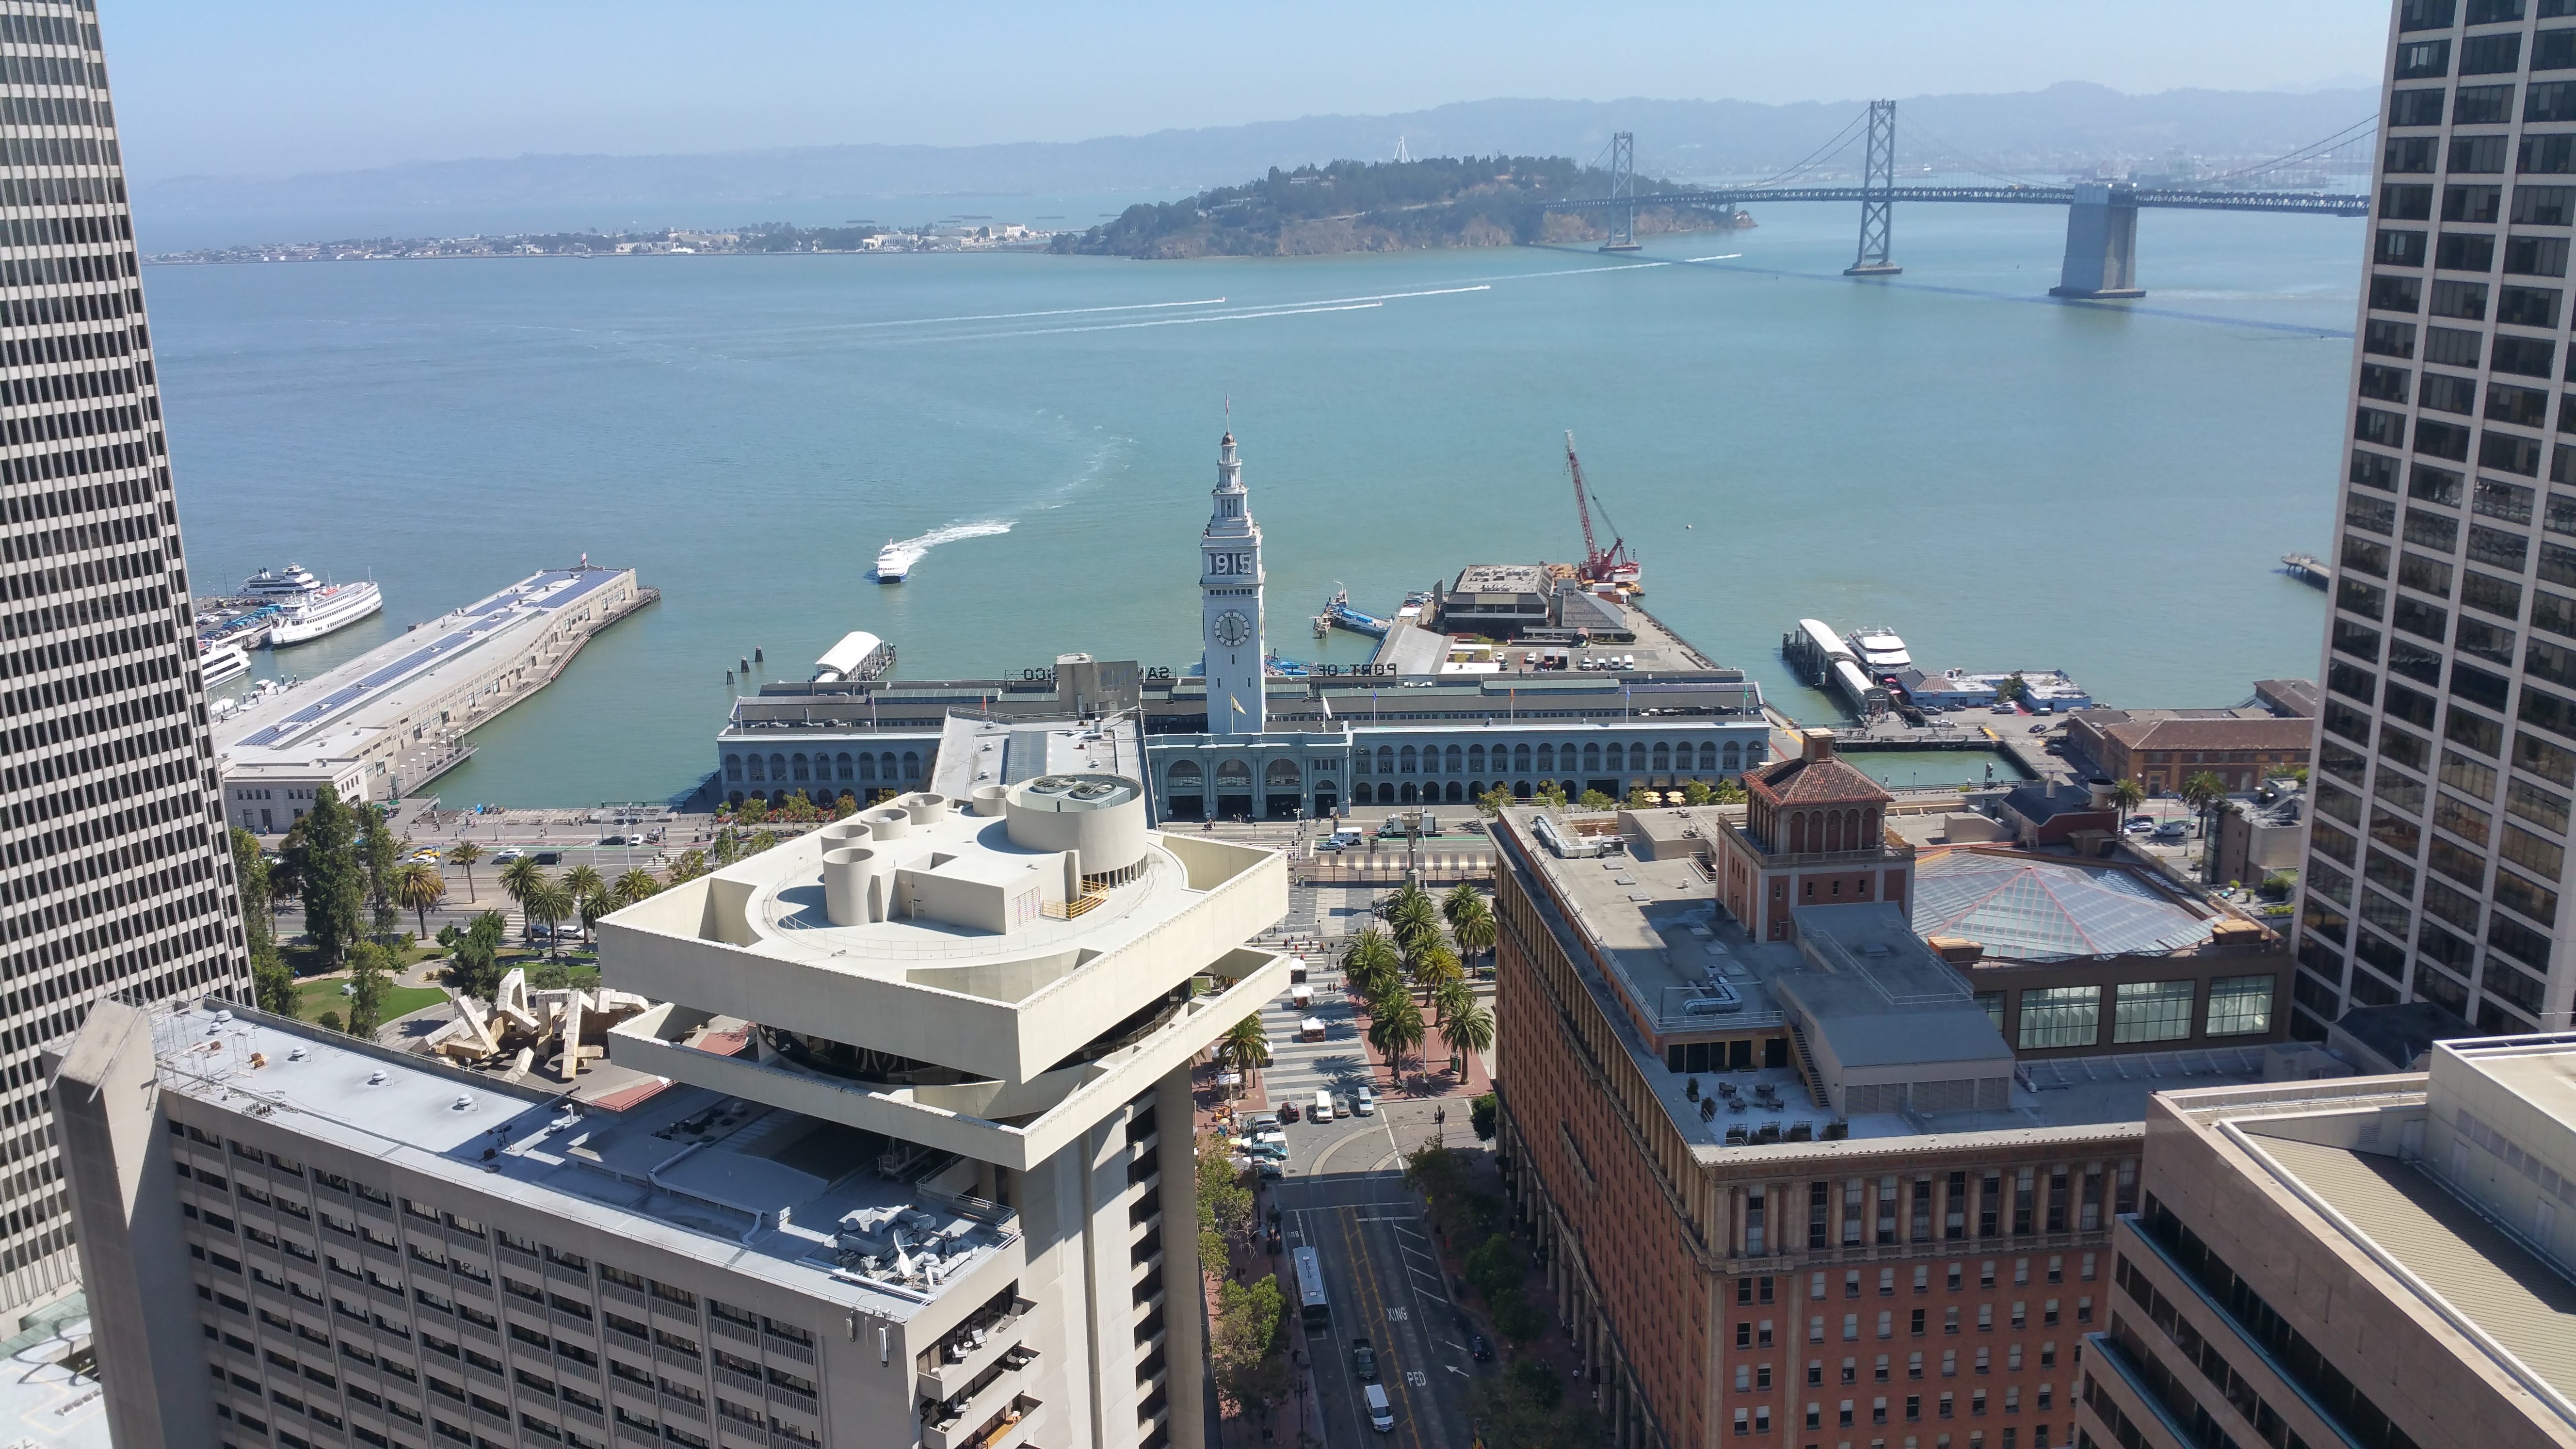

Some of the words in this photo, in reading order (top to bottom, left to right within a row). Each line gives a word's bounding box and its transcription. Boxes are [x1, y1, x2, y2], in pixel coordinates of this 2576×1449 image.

[1208, 555, 1251, 573] 1915
[1386, 1307, 1408, 1321] XING
[1406, 1371, 1427, 1387] PED
